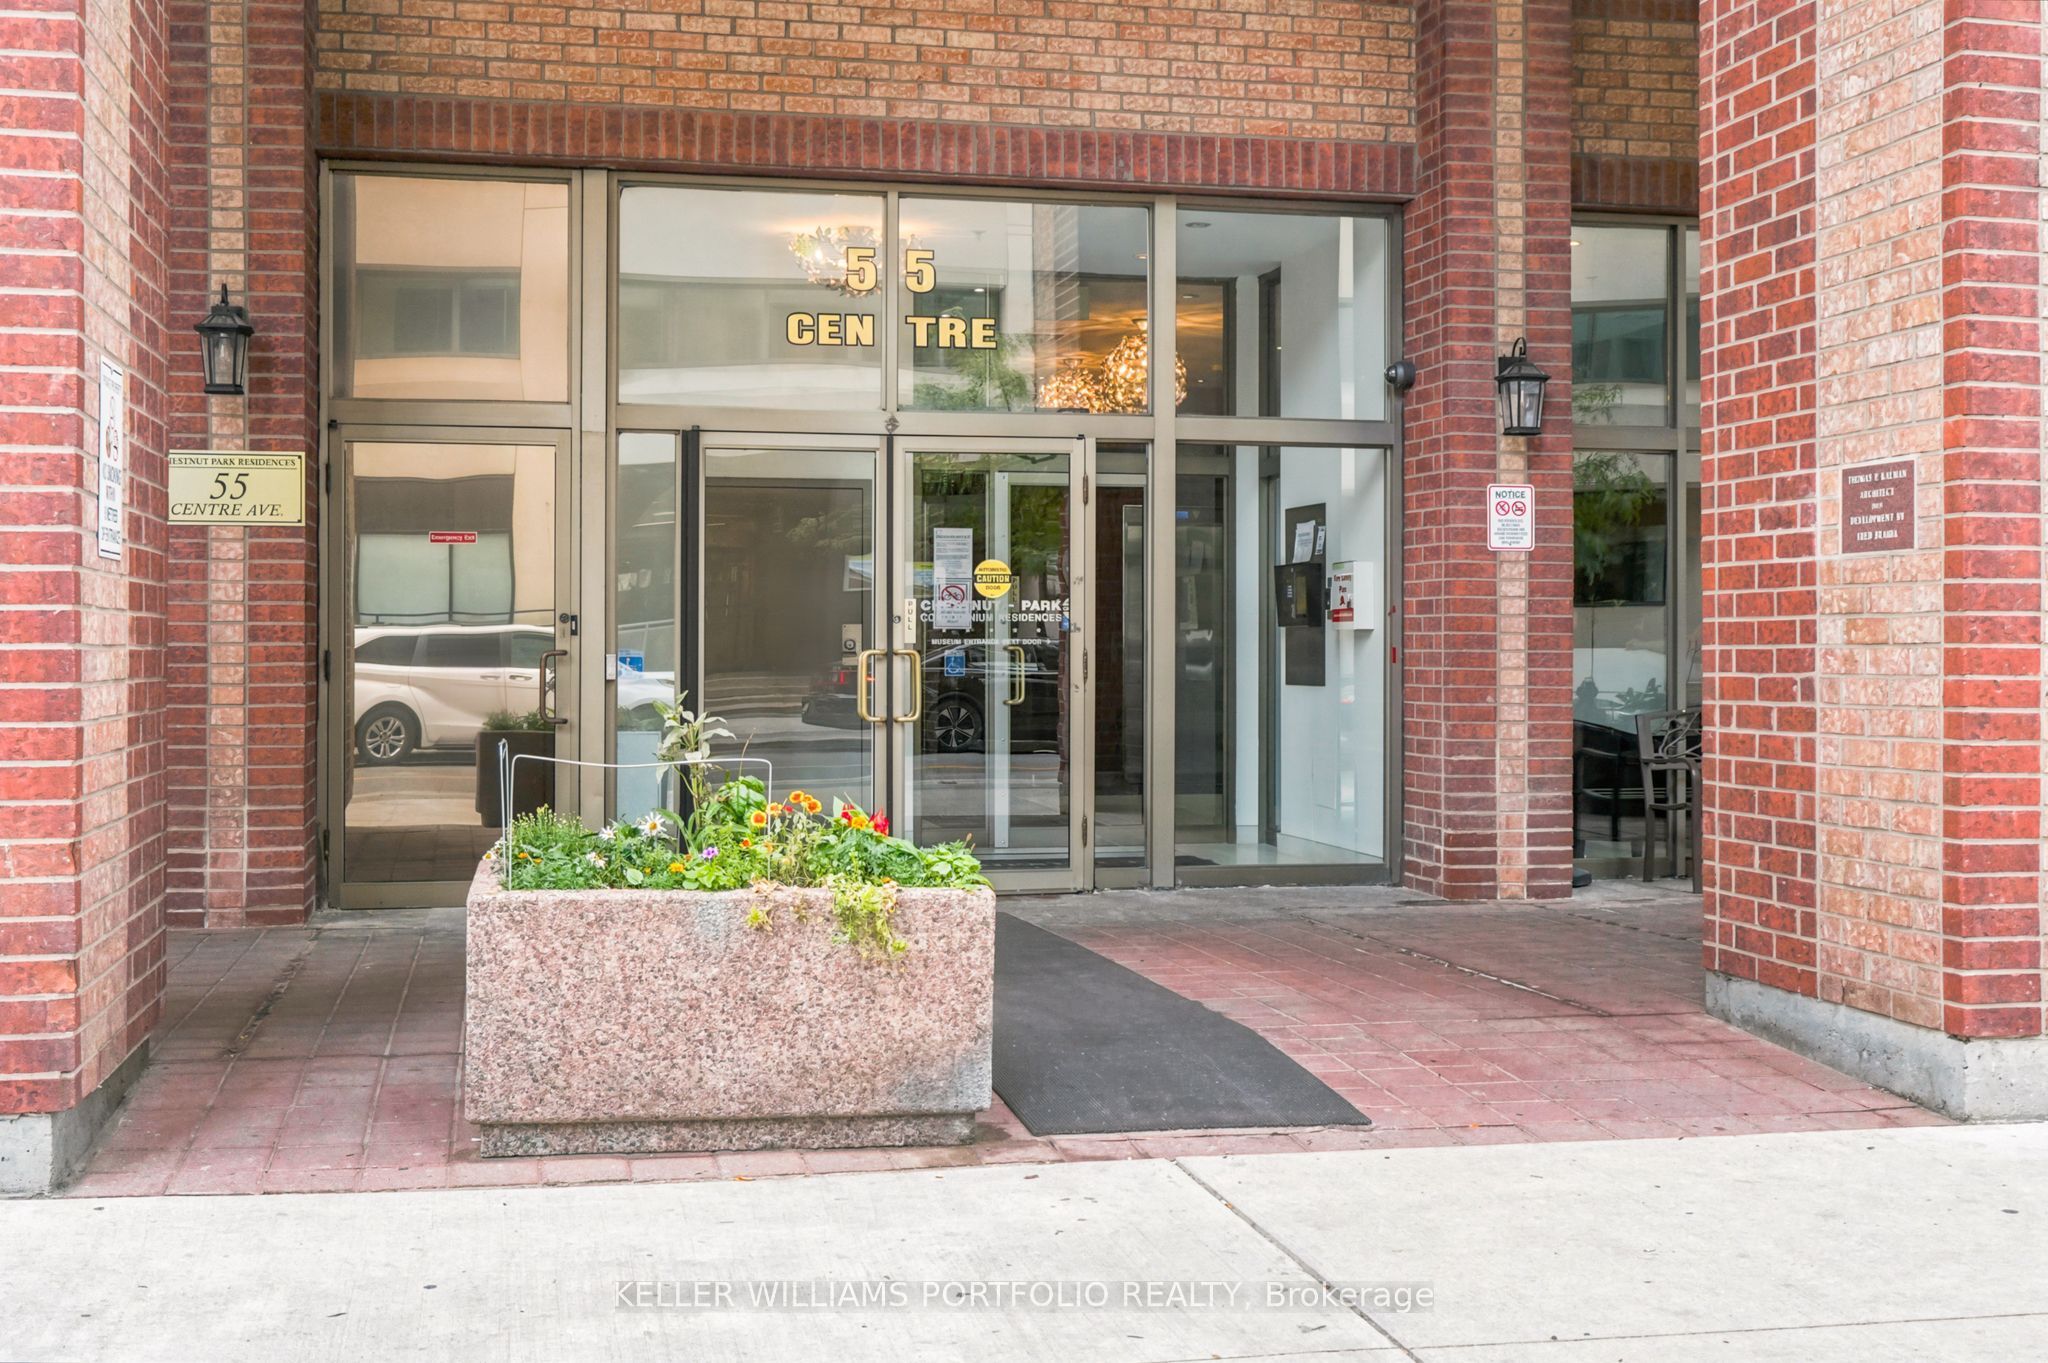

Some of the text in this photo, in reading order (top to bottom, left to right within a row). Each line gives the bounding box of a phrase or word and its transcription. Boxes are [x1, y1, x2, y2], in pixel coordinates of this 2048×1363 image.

[211, 458, 235, 466] PARK
[238, 458, 296, 467] RESIDENCES
[209, 472, 250, 500] 55
[1495, 490, 1526, 499] NOTICE
[1860, 487, 1895, 499] ARCHITECT
[171, 502, 284, 517] CENTRE AVE.
[976, 574, 1010, 583] CAUTION
